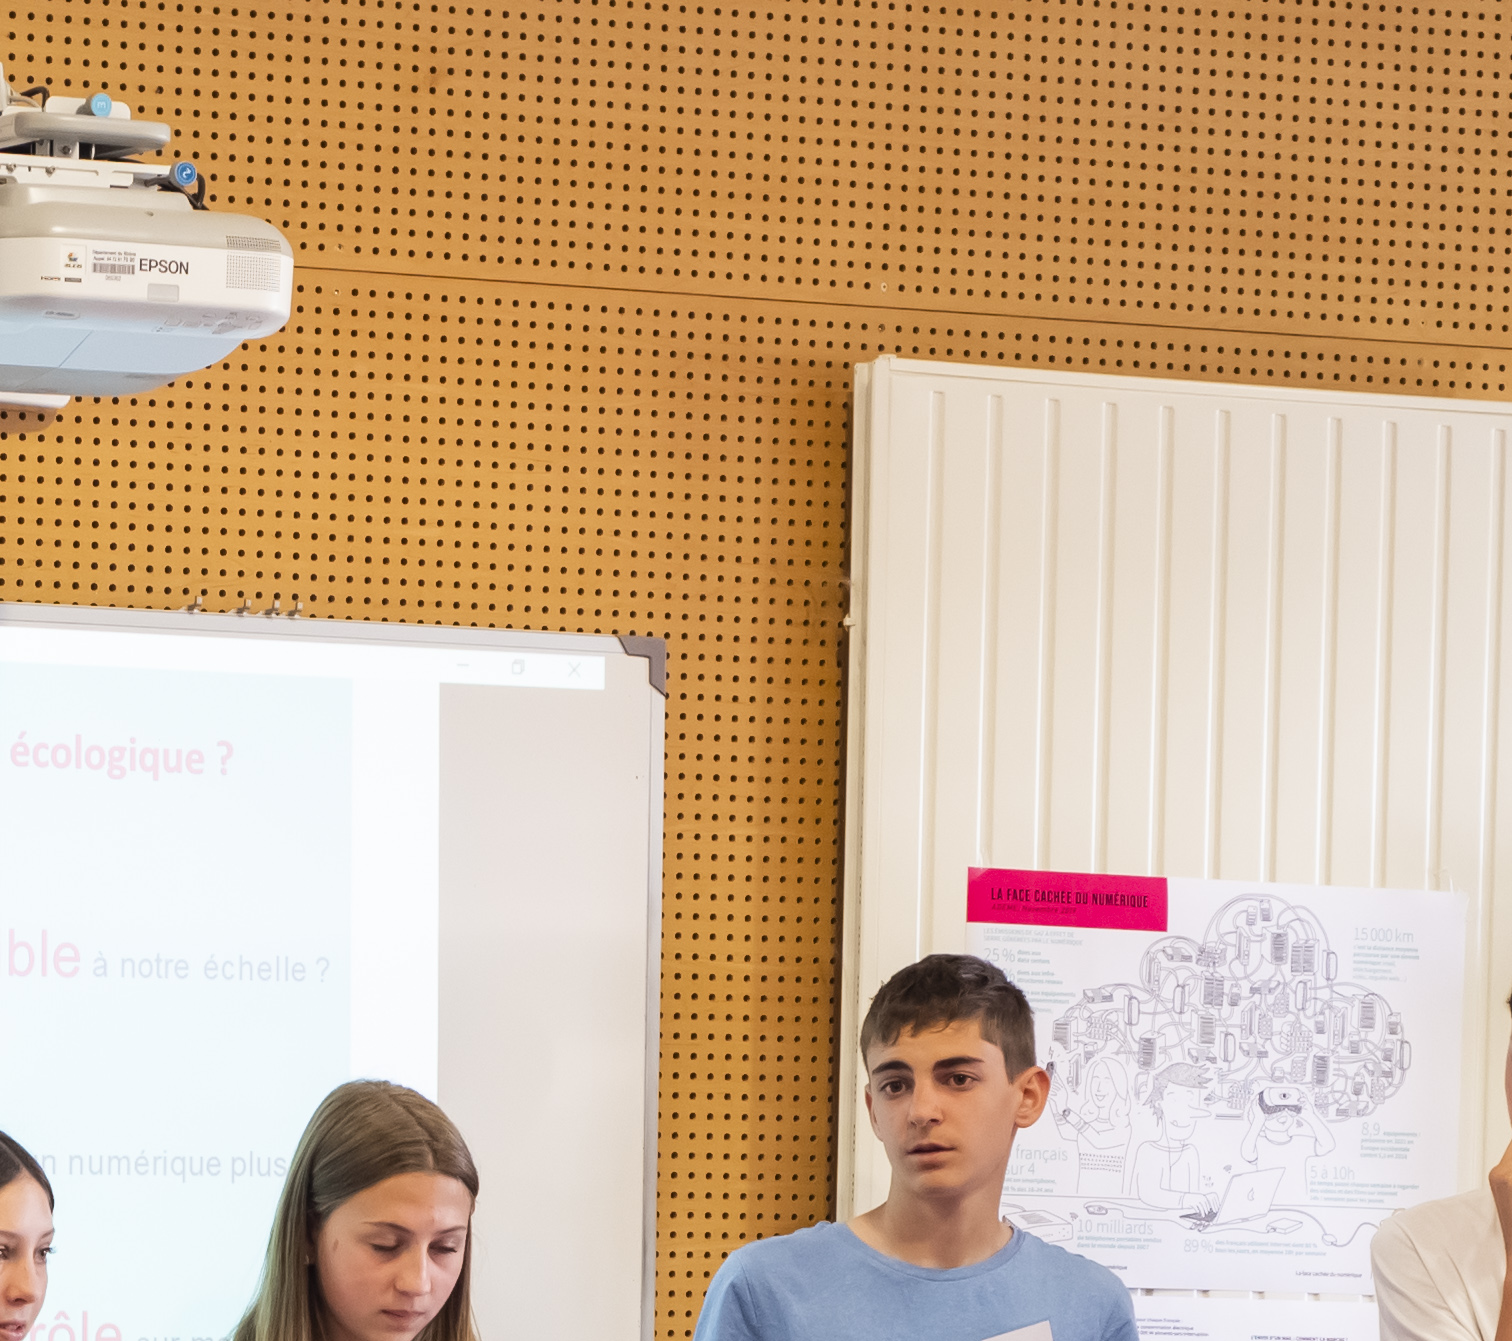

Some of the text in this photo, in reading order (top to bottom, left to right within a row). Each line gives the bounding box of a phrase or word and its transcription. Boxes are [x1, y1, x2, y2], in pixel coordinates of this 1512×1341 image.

[139, 257, 190, 276] EPSON
[10, 730, 206, 781] écologique
[217, 739, 234, 776] ?
[991, 888, 1004, 901] LA
[1007, 889, 1031, 902] FACE
[1076, 892, 1088, 905] DU
[1091, 891, 1149, 908] NUMÉRIQUE
[1395, 928, 1415, 943] km
[92, 949, 109, 978] à
[119, 953, 190, 981] notre
[203, 951, 307, 983] échelle
[315, 955, 330, 983] ?
[1361, 1122, 1381, 1138] 8,9
[1015, 1144, 1068, 1163] français
[69, 1149, 222, 1184] numérique
[231, 1150, 287, 1183] plus
[1027, 1162, 1036, 1175] 4
[1310, 1164, 1355, 1180] 5 à 10h
[1077, 1219, 1154, 1236] 10 milliards
[1183, 1238, 1199, 1253] 89
[1201, 1239, 1214, 1253] %
